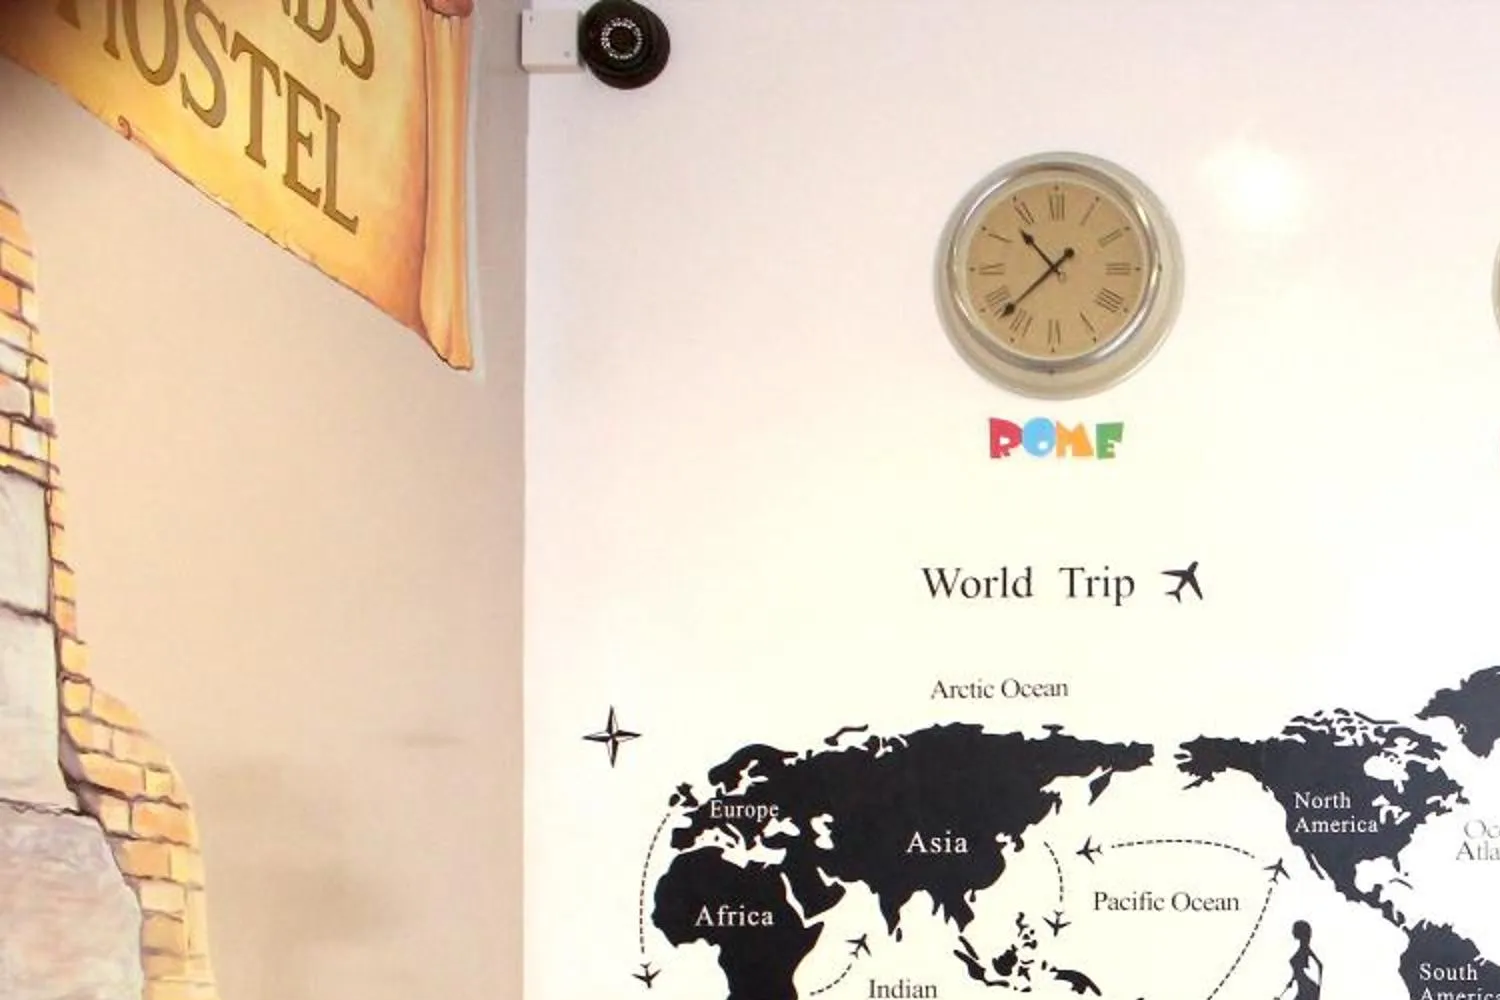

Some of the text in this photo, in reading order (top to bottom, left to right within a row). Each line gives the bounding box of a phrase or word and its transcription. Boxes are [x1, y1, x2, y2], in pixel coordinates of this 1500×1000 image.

[988, 416, 1124, 459] ROME
[921, 565, 1136, 606] World Trip
[931, 677, 1069, 700] Arctic Ocean
[709, 800, 780, 821] Europe
[1294, 791, 1352, 809] North
[1294, 815, 1379, 834] America
[906, 829, 970, 854] Asia
[1092, 891, 1240, 912] Pacific Ocean
[694, 904, 775, 927] Africa
[1418, 962, 1480, 982] South
[868, 978, 938, 999] Indian
